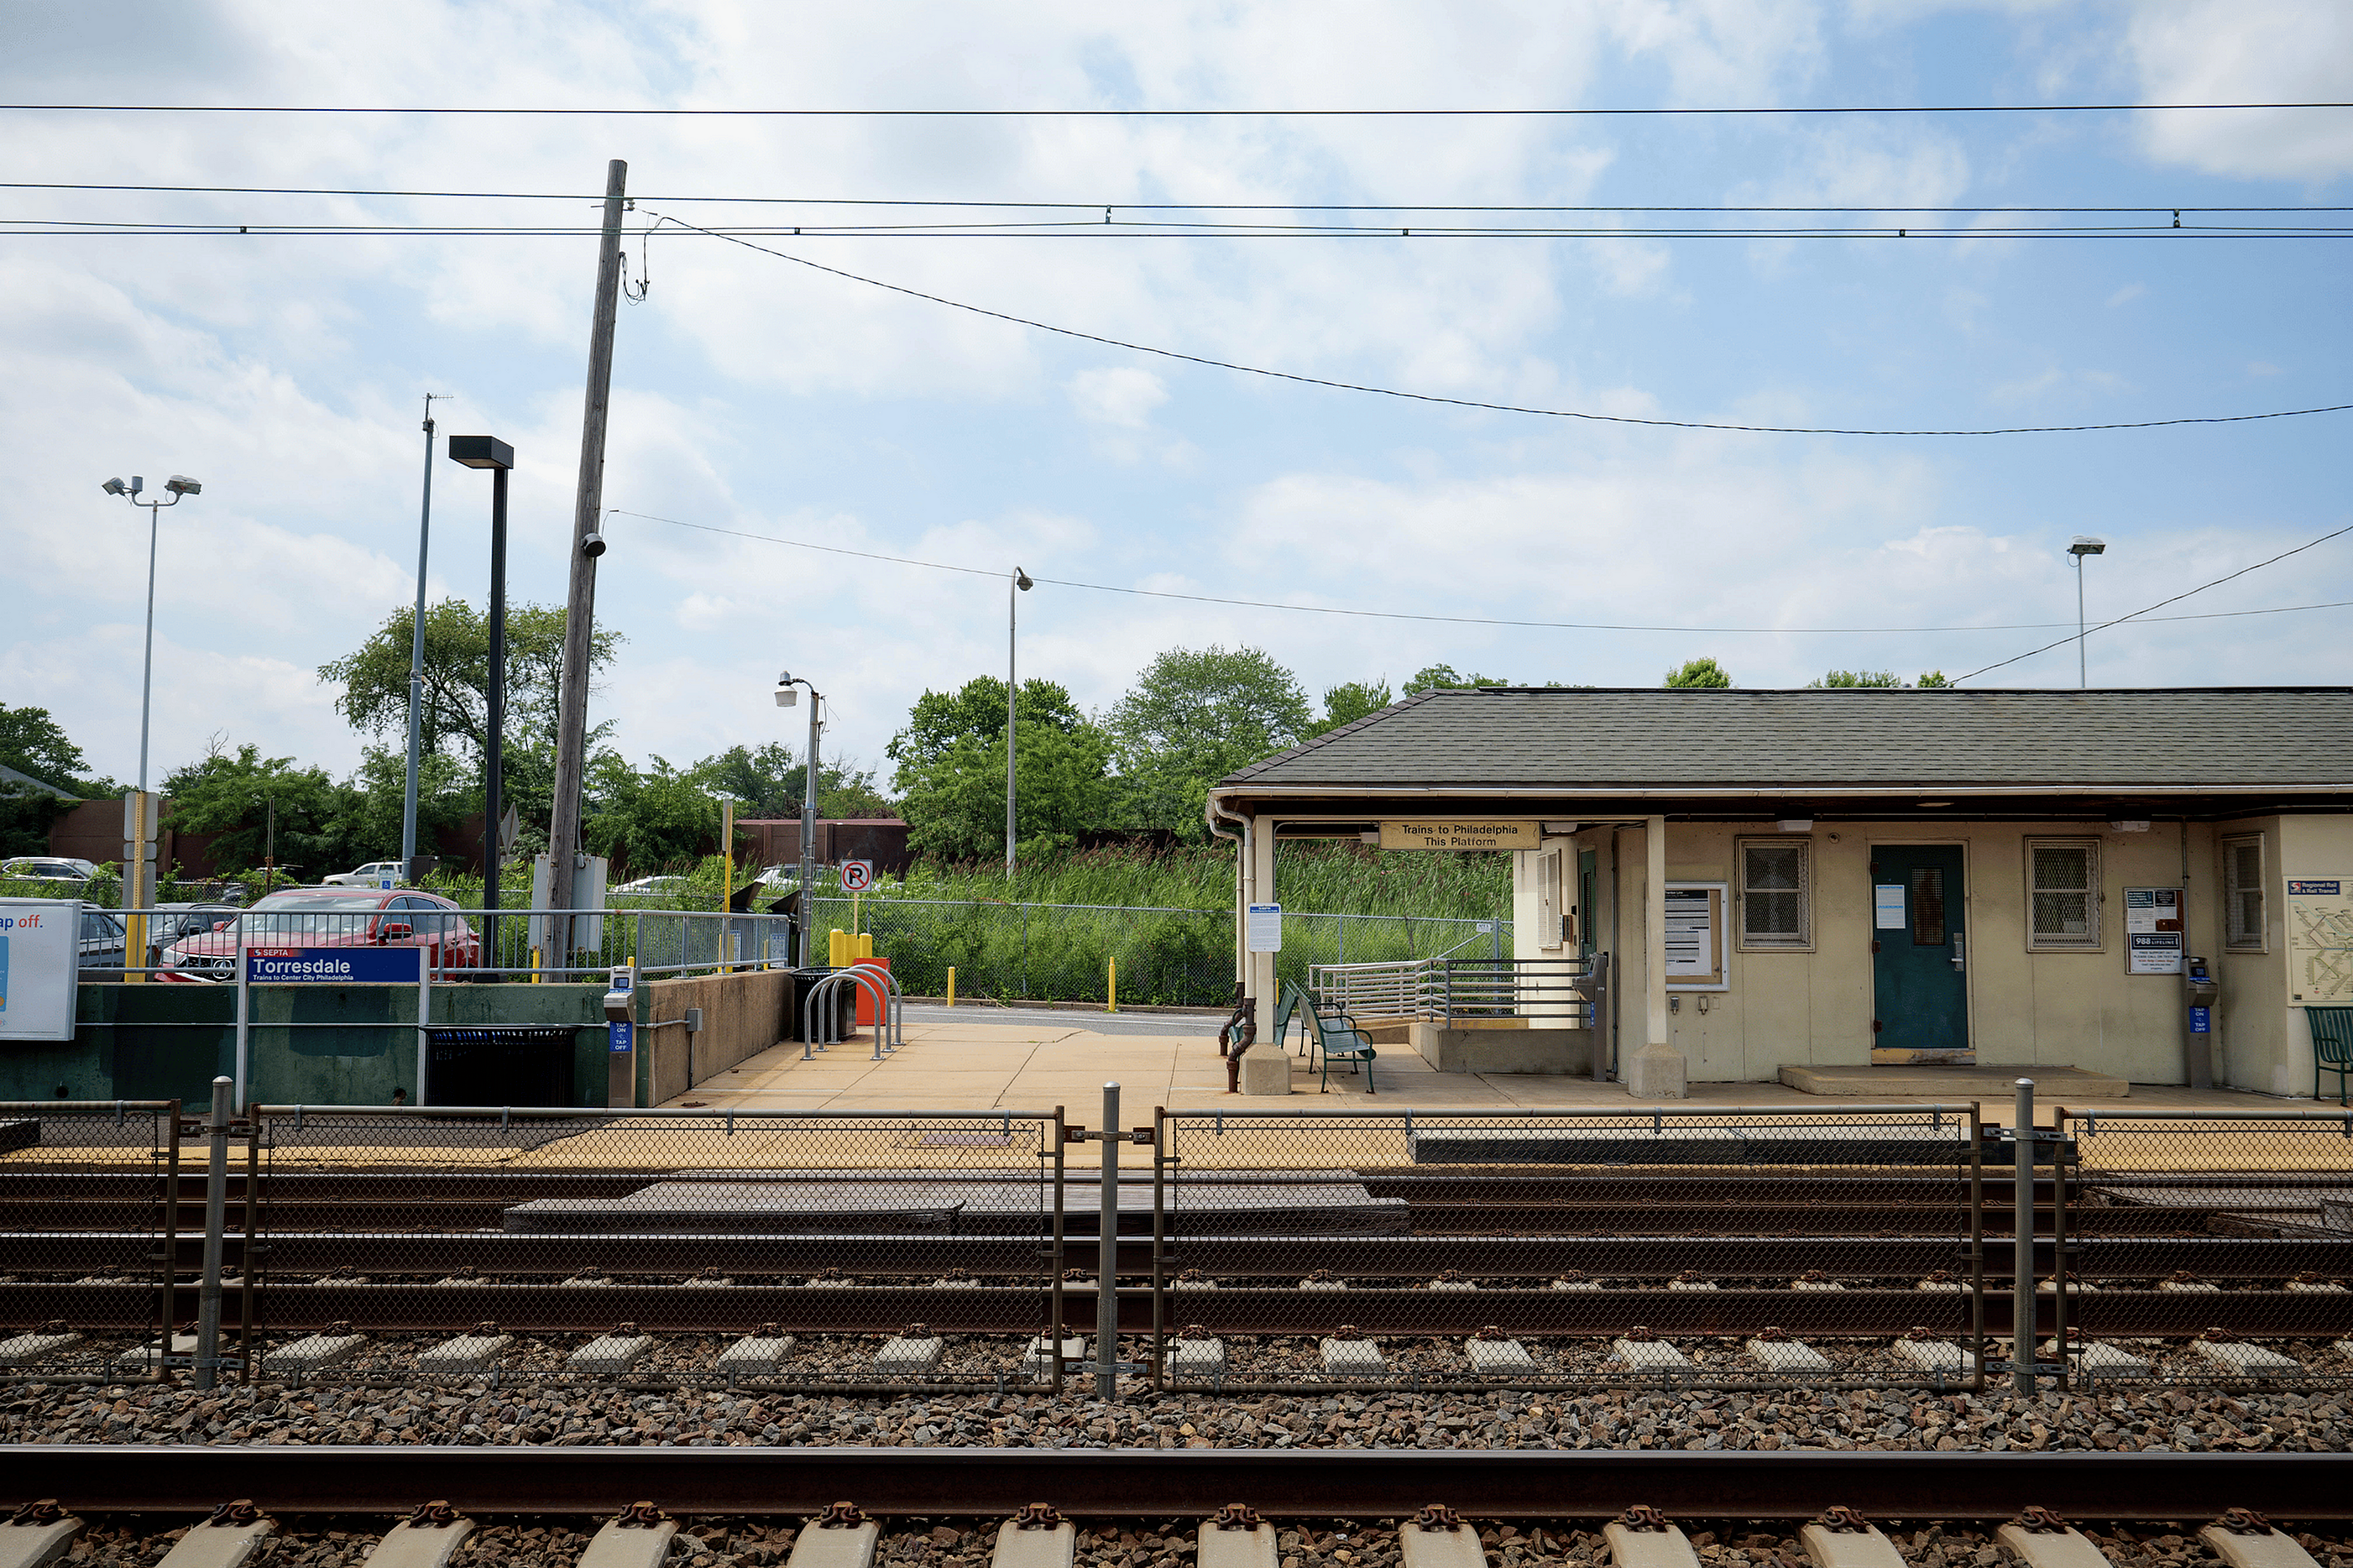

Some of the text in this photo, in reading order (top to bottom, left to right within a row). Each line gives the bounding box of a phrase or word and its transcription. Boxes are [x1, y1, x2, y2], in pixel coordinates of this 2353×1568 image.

[1402, 825, 1518, 836] Trains to Philadelphia
[1424, 837, 1496, 846] This Platform
[18, 914, 43, 928] off.
[253, 959, 351, 974] Torresdale
